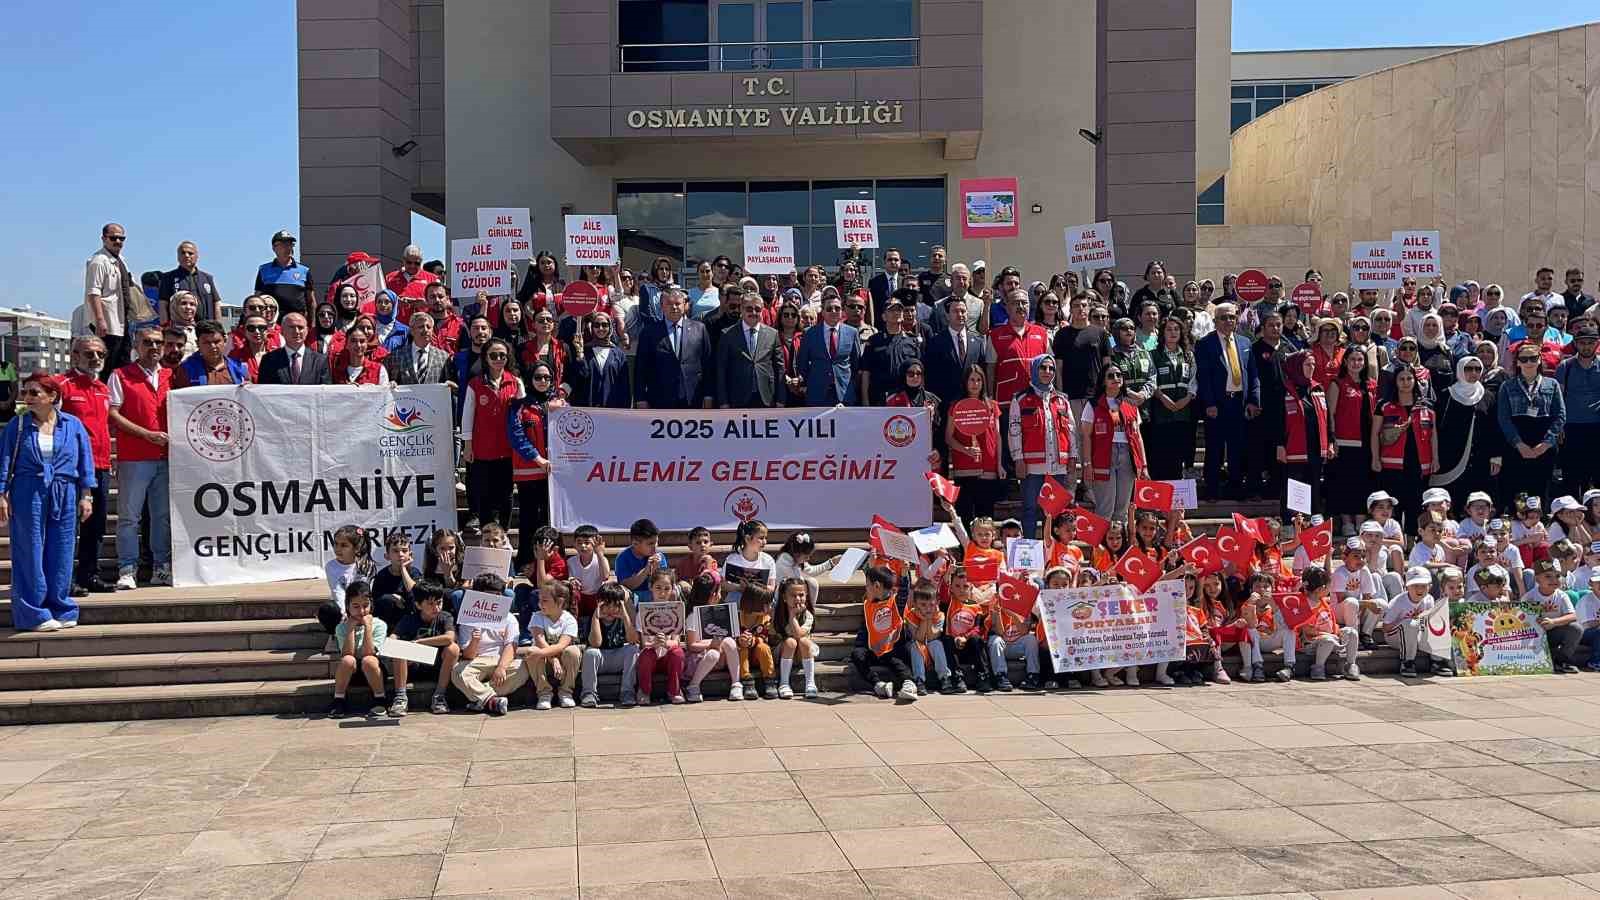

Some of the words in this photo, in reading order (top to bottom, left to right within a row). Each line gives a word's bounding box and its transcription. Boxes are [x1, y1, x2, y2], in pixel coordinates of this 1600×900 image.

[743, 77, 791, 97] T.C.
[627, 104, 770, 129] OSMANİYE
[779, 100, 904, 127] VALİLİĞİ
[844, 202, 868, 215] AİLE
[496, 215, 513, 225] AİLE
[582, 217, 602, 231] AİLE
[843, 219, 872, 229] EMEK
[488, 226, 523, 238] GİRİLMEZ
[844, 232, 874, 243] İSTER
[511, 240, 529, 250] EDİR
[569, 234, 617, 246] TOPLUMUN
[1403, 235, 1430, 247] AİLE
[471, 242, 492, 257] AİLE
[575, 247, 612, 260] ÖZÜDÜR
[758, 244, 780, 254] HAYATI
[1369, 247, 1386, 258] AİLE
[455, 260, 508, 273] TOPLUMUN
[747, 255, 793, 265] PAYLAŞMAKTIR
[1352, 258, 1402, 270] MUTLULUĞUN
[461, 274, 501, 290] ÖZÜDÜR
[650, 419, 715, 440] 2025
[723, 413, 779, 440] AİLE
[787, 418, 837, 440] YILI
[586, 455, 704, 483] AİLEMİZ
[711, 454, 898, 482] GELECEĞİMİZ
[193, 468, 438, 519] OSMANİYE
[194, 527, 314, 561] GENÇLİK
[472, 599, 500, 613] AİLE
[1097, 598, 1159, 619] ŞEKER
